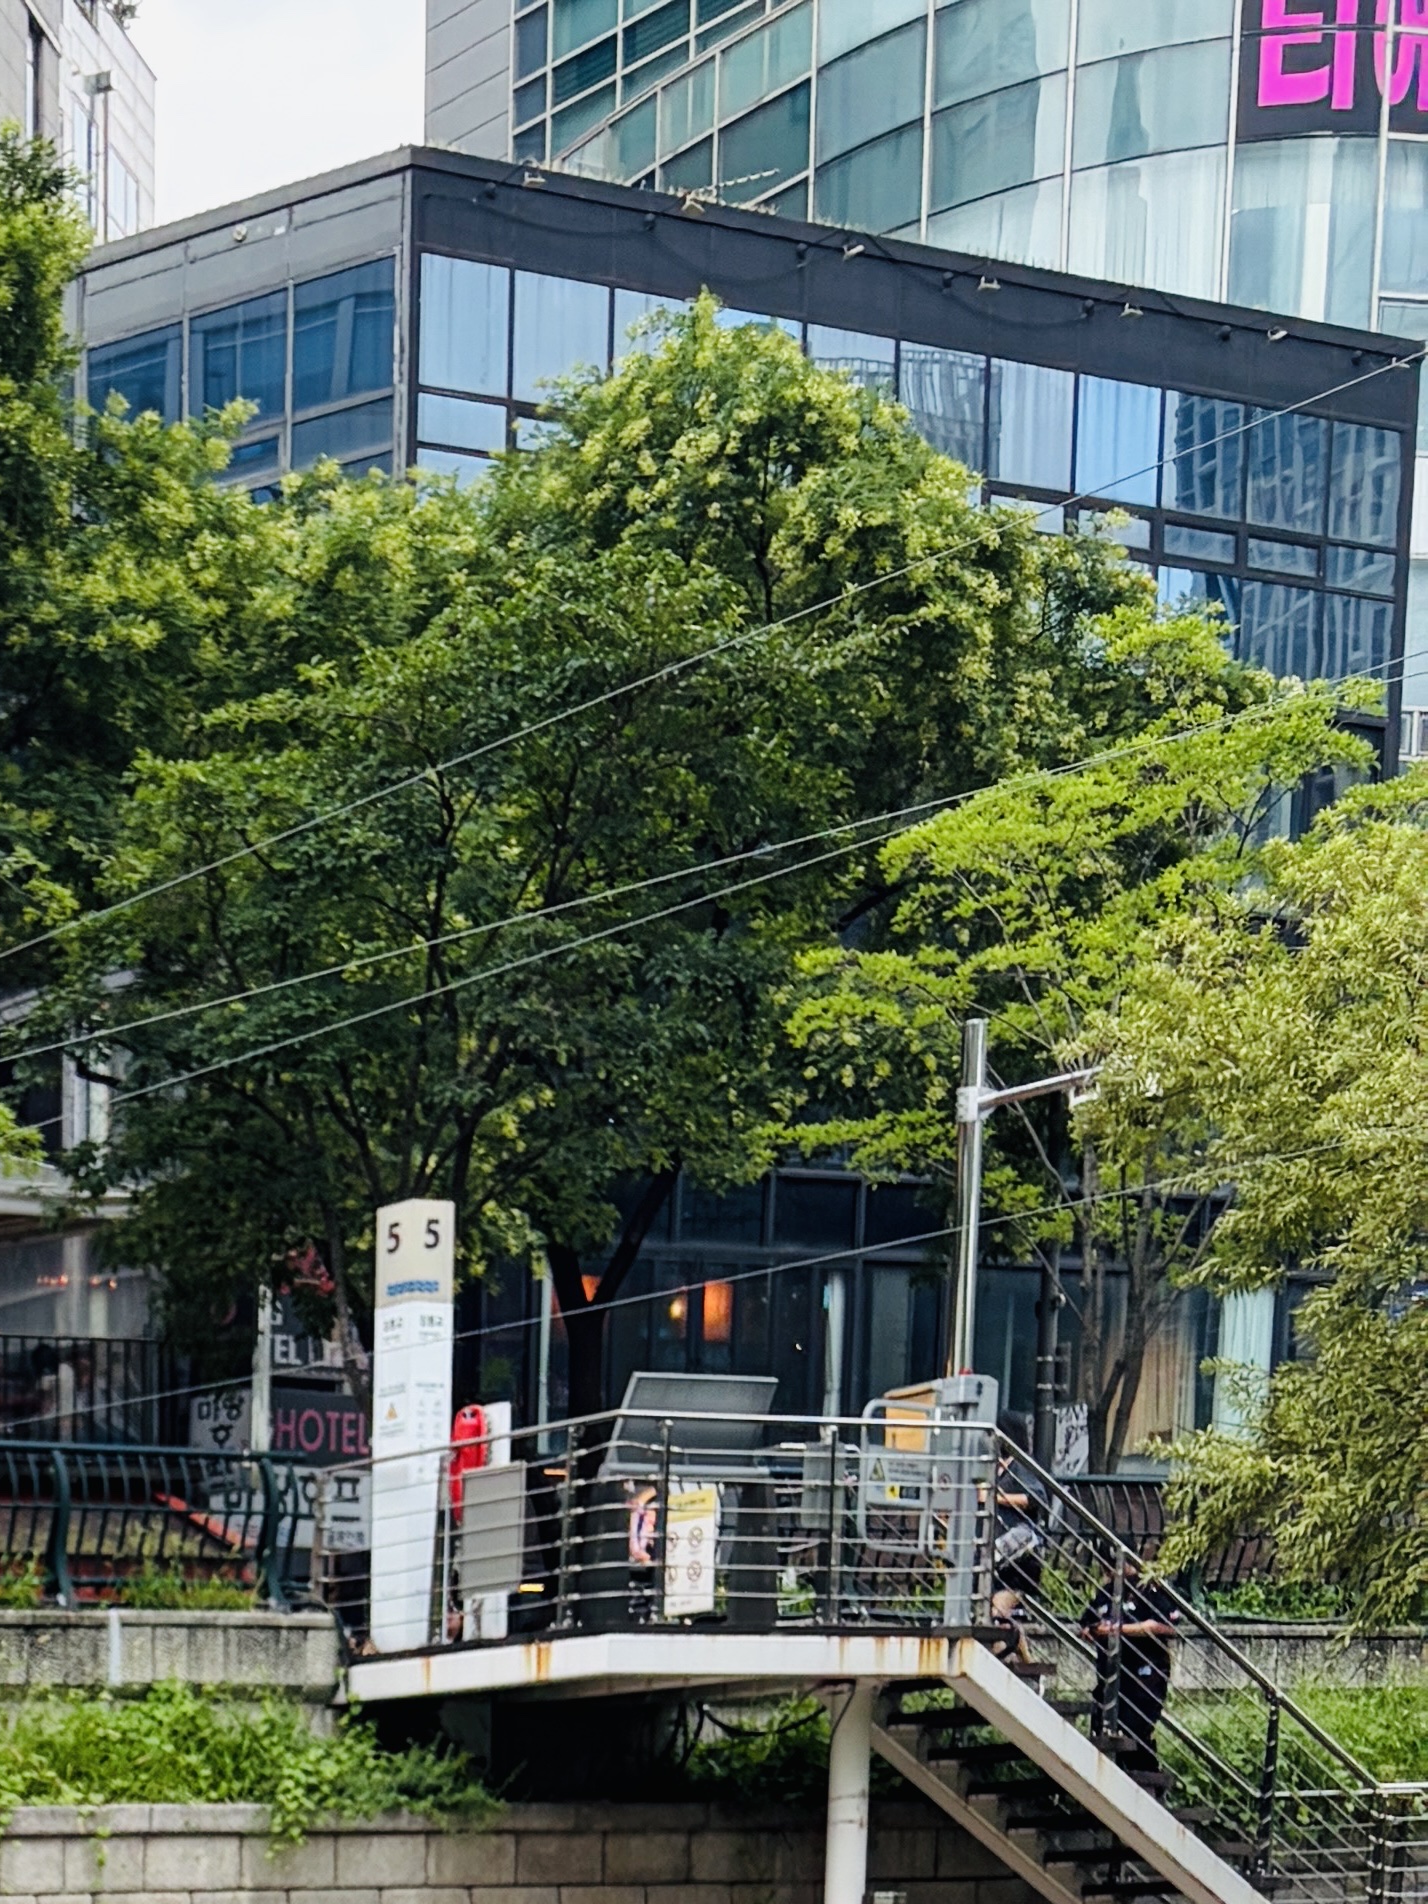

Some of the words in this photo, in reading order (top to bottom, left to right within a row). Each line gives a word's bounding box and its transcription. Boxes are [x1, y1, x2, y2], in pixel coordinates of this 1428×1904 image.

[386, 1222, 401, 1254] 5
[424, 1218, 440, 1250] 5
[275, 1408, 370, 1455] HOTEL
